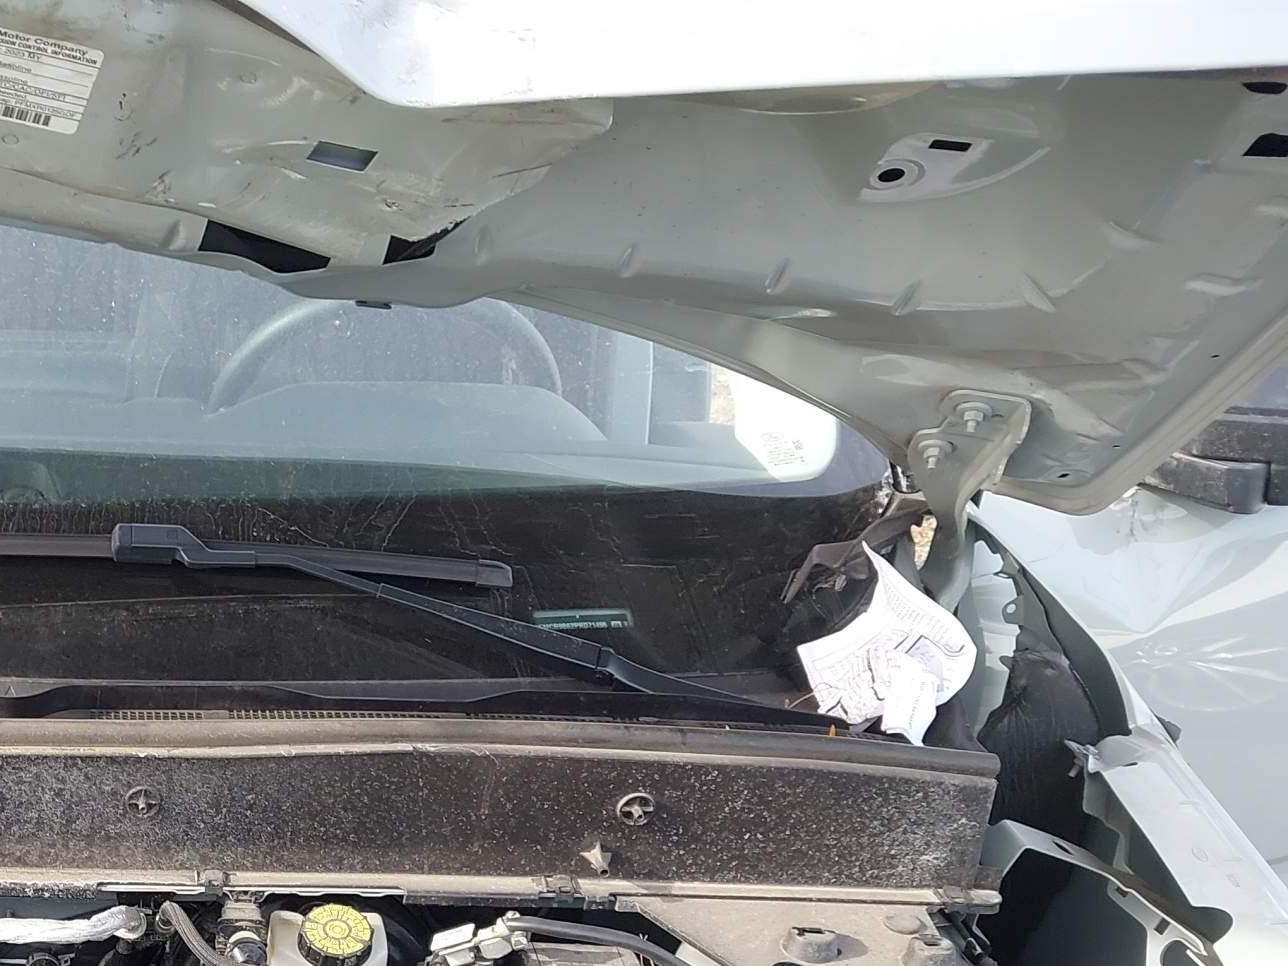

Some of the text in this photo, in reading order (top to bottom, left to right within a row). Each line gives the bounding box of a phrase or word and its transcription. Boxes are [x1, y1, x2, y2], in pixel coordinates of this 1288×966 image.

[18, 42, 49, 54] CONTROL
[50, 49, 98, 65] INFORMATION
[34, 38, 88, 56] Company
